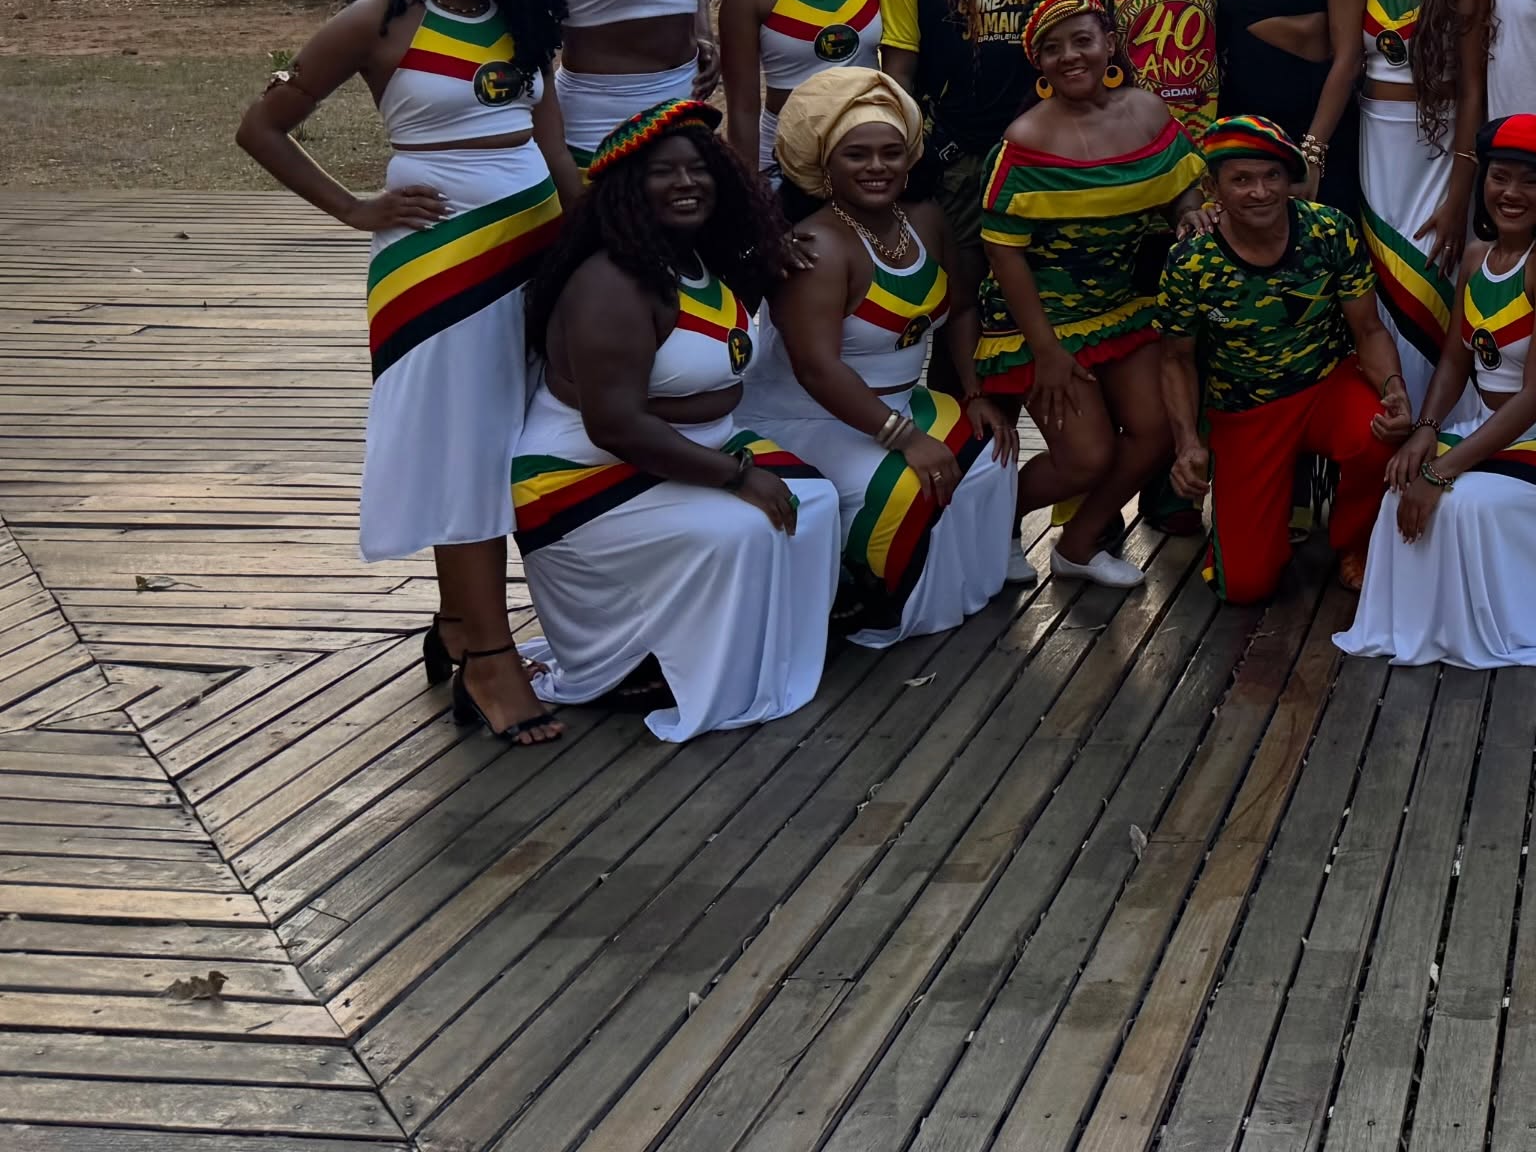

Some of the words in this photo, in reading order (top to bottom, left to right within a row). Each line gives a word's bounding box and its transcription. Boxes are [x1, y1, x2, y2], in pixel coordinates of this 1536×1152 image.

[1132, 3, 1207, 56] 40
[1137, 48, 1211, 82] ANOS
[1160, 87, 1198, 98] GDAM
